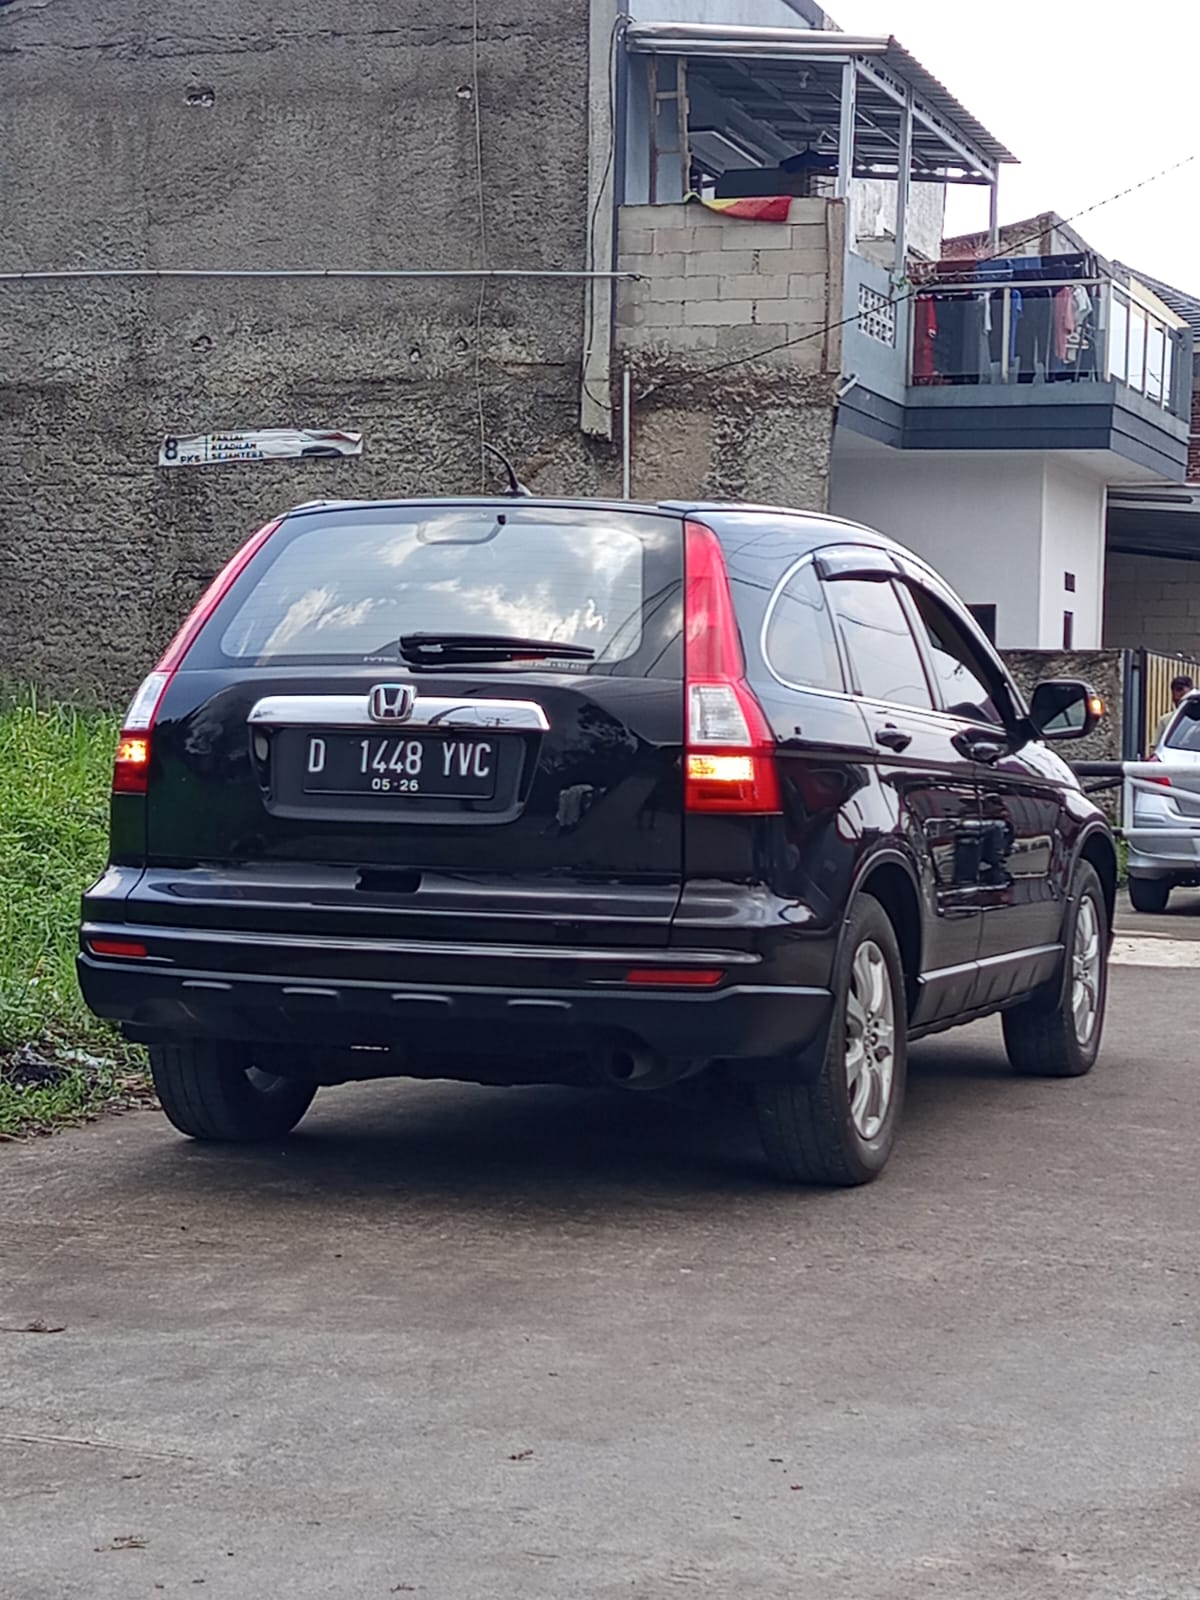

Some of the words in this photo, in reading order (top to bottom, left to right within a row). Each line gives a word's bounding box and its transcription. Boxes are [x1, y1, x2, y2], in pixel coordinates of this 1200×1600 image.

[164, 438, 178, 460] 8
[180, 455, 201, 463] PKS
[308, 738, 326, 772] D
[360, 740, 423, 775] 1448
[442, 741, 492, 776] YVC
